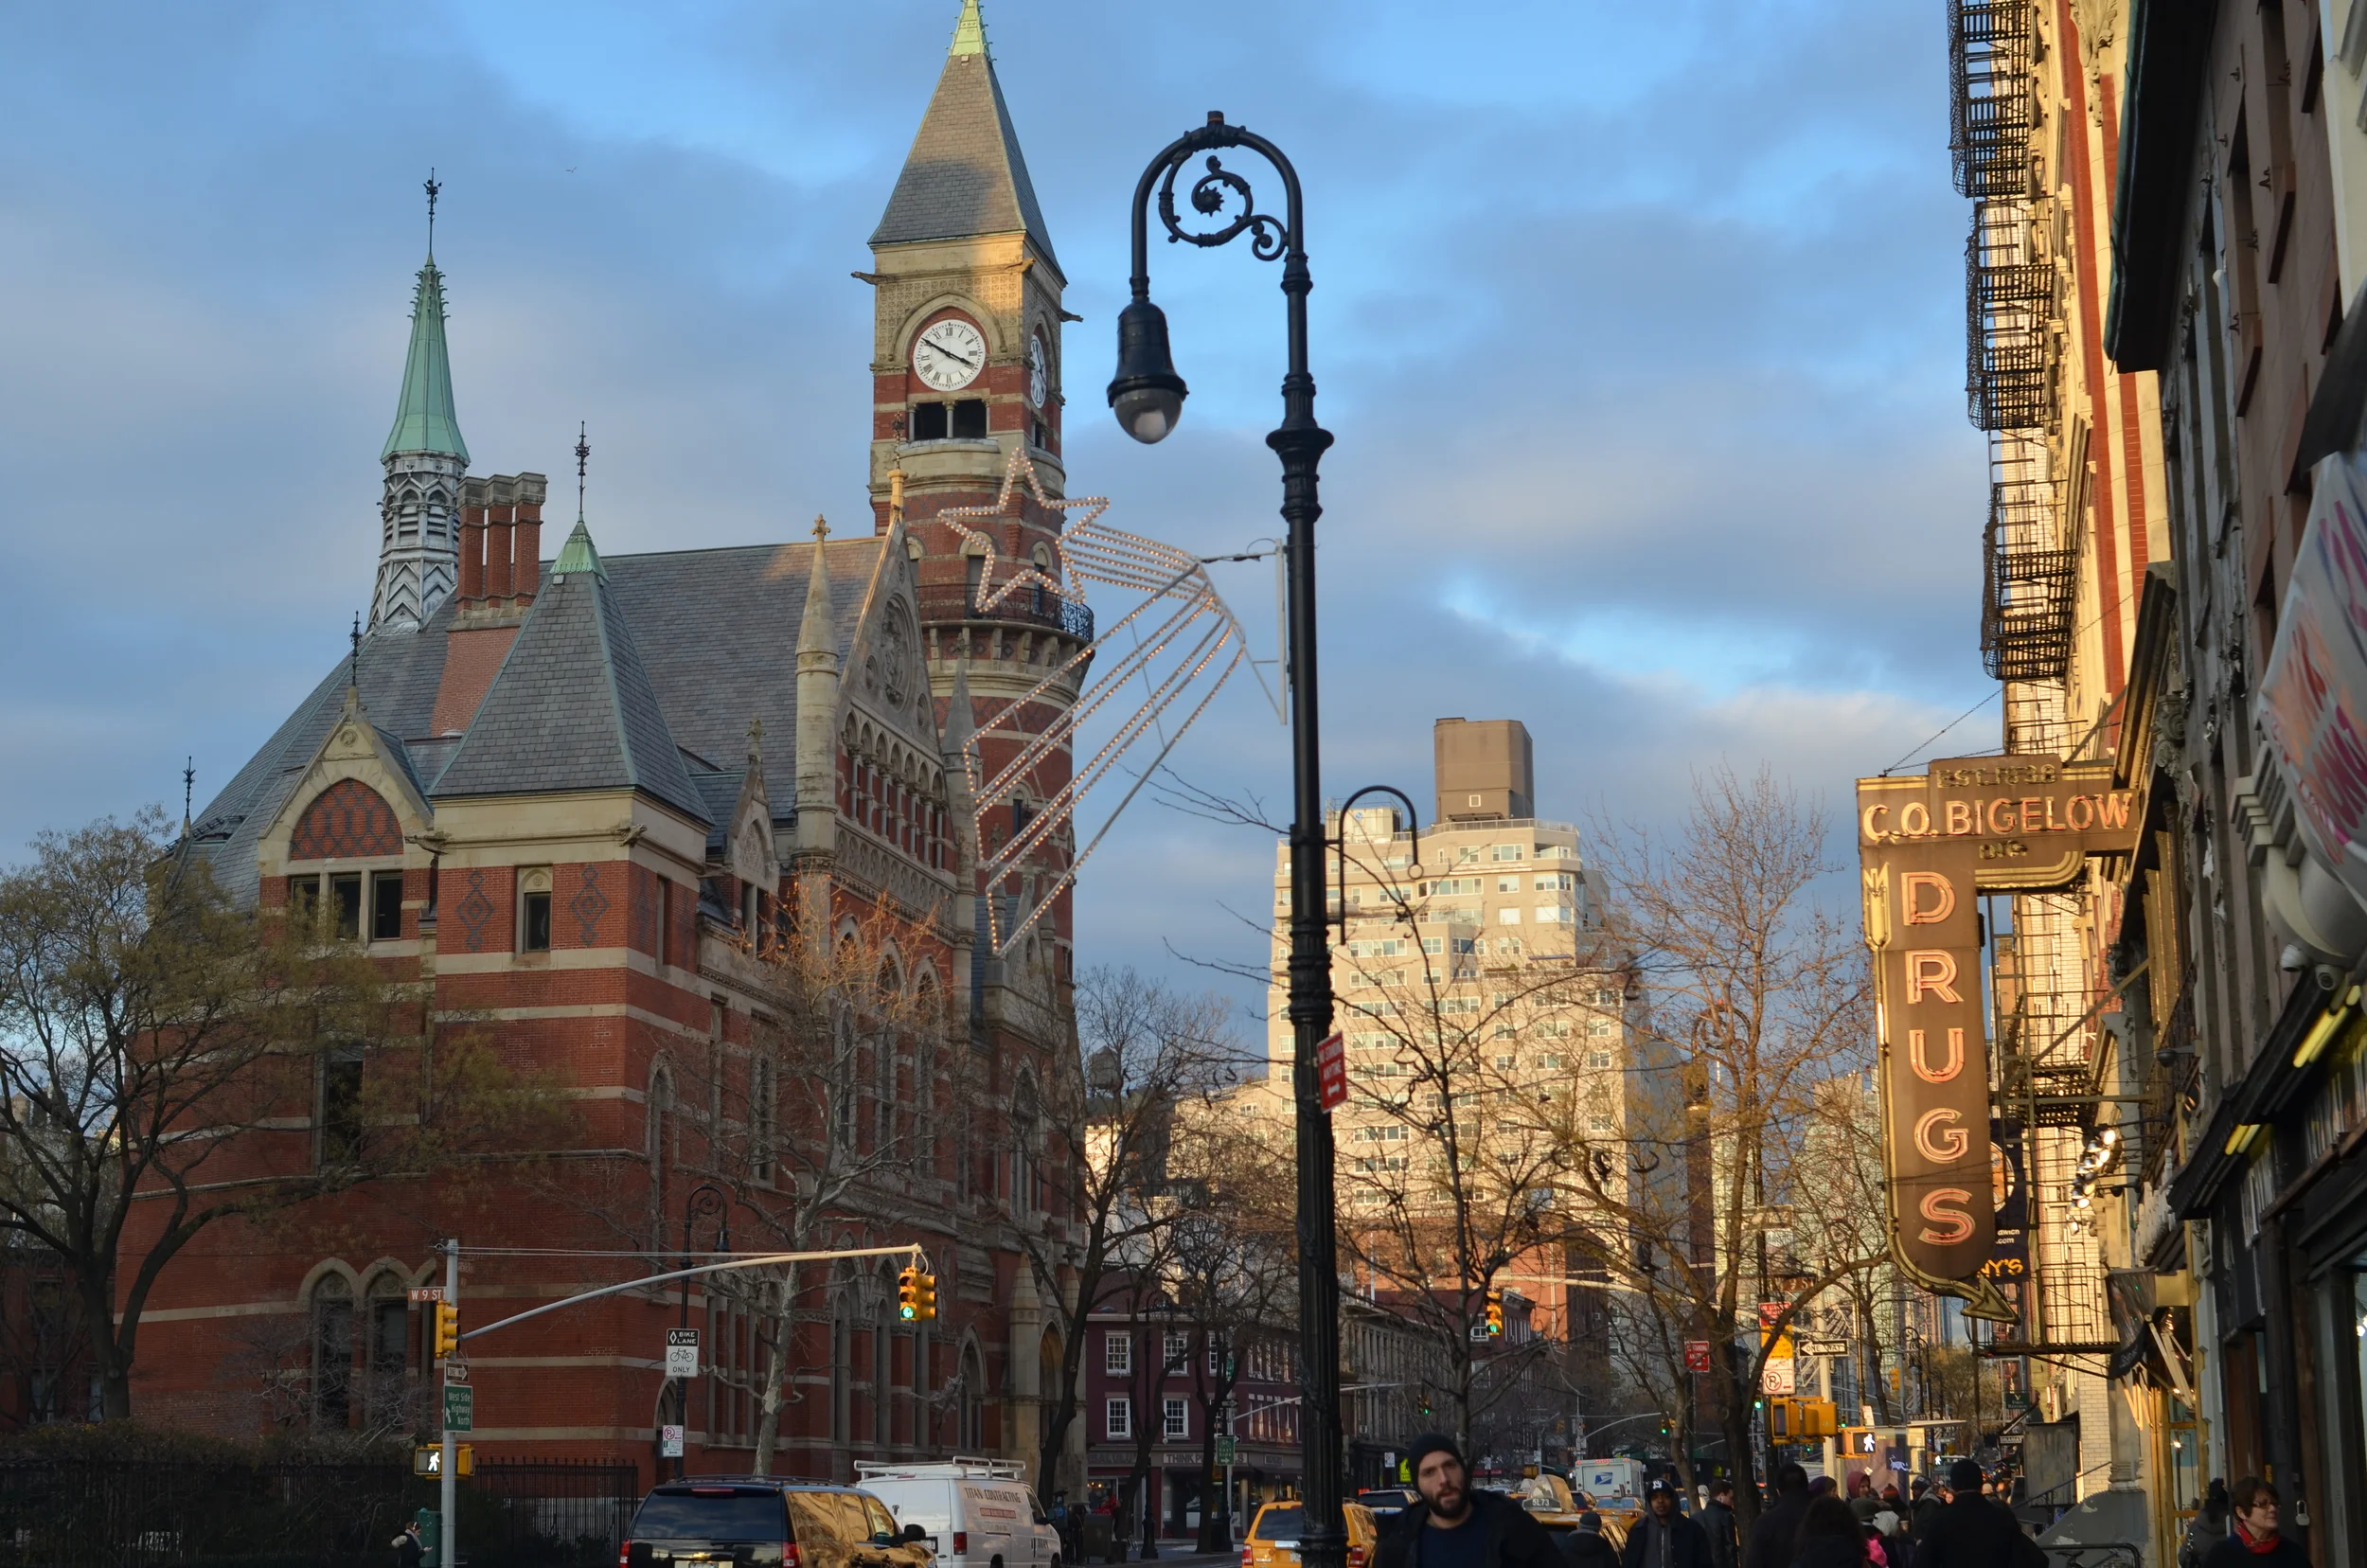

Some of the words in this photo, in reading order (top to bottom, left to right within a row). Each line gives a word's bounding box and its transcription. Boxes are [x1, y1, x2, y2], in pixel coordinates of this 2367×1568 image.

[1996, 764, 2056, 785] 1838
[1946, 793, 2133, 836] BIGELOW
[1900, 871, 1976, 1245] DRUGS
[1977, 1258, 2024, 1278] NY'S
[411, 1290, 418, 1300] W
[422, 1289, 429, 1300] 9
[432, 1289, 442, 1300] ST
[448, 1392, 459, 1401] West
[460, 1393, 471, 1401] Side
[451, 1403, 471, 1416] Highway
[457, 1416, 471, 1425] North
[964, 1488, 984, 1500] TITAN
[984, 1488, 1022, 1503] CONTRACTING
